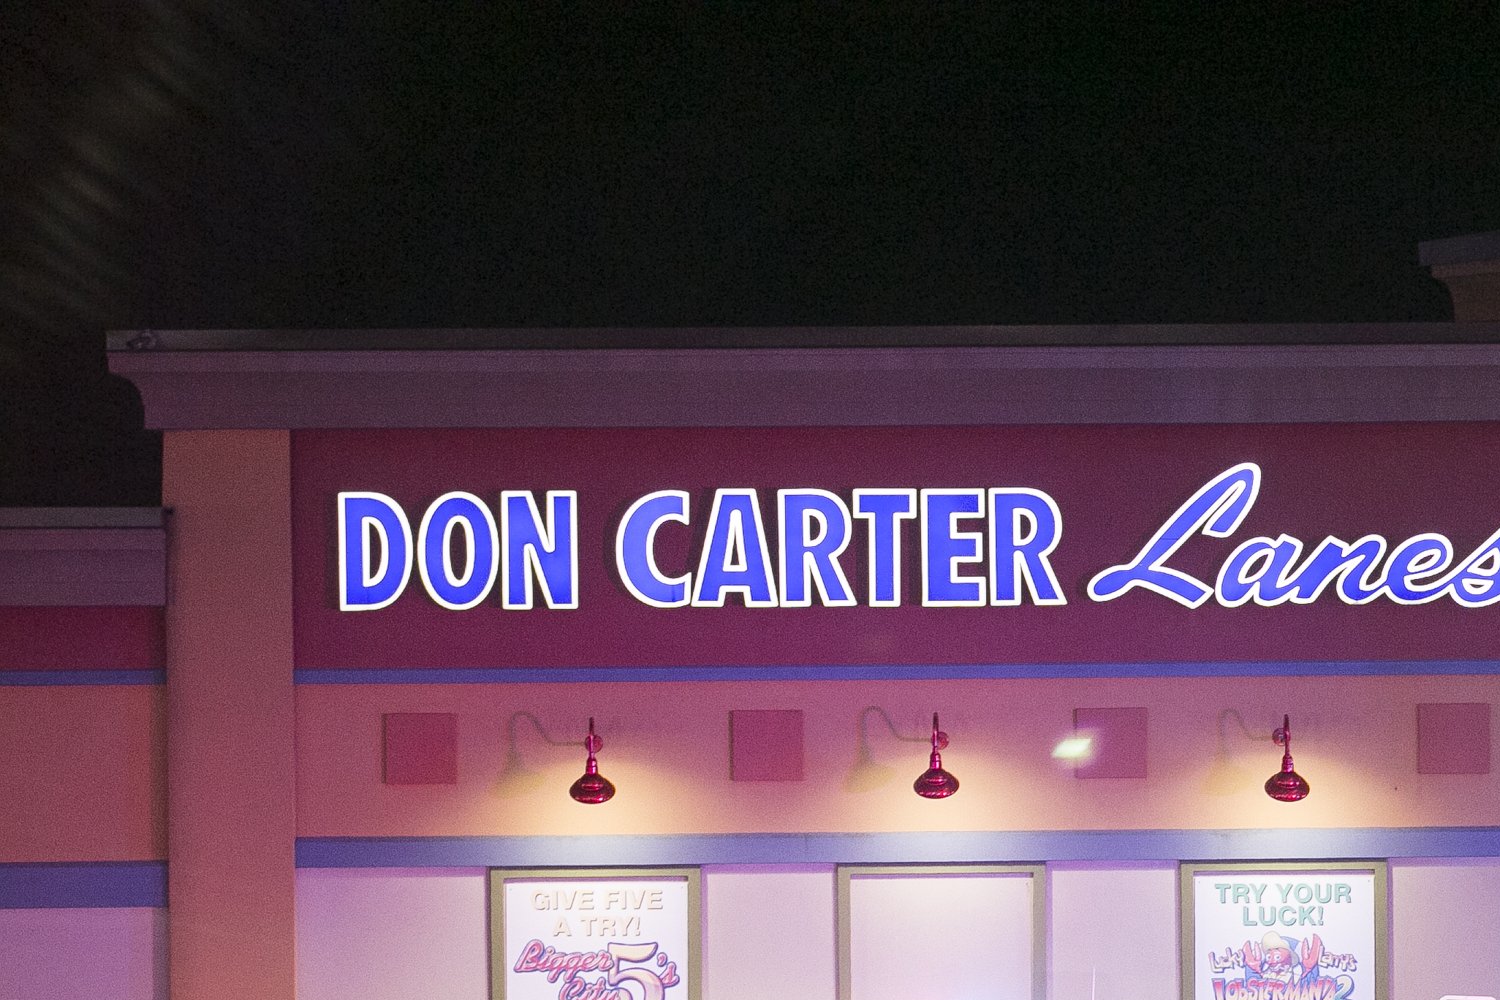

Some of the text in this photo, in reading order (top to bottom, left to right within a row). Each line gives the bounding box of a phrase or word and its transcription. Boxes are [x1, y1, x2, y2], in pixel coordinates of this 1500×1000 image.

[337, 490, 578, 612] DON
[615, 488, 1068, 608] CARTER
[532, 889, 664, 911] GIVE FIVE
[1214, 883, 1352, 904] TRY YOUR
[552, 916, 641, 937] A TRY!
[1242, 906, 1325, 927] LUCK!
[513, 939, 614, 983] Bigger
[1208, 945, 1358, 974] Lucky Larry's
